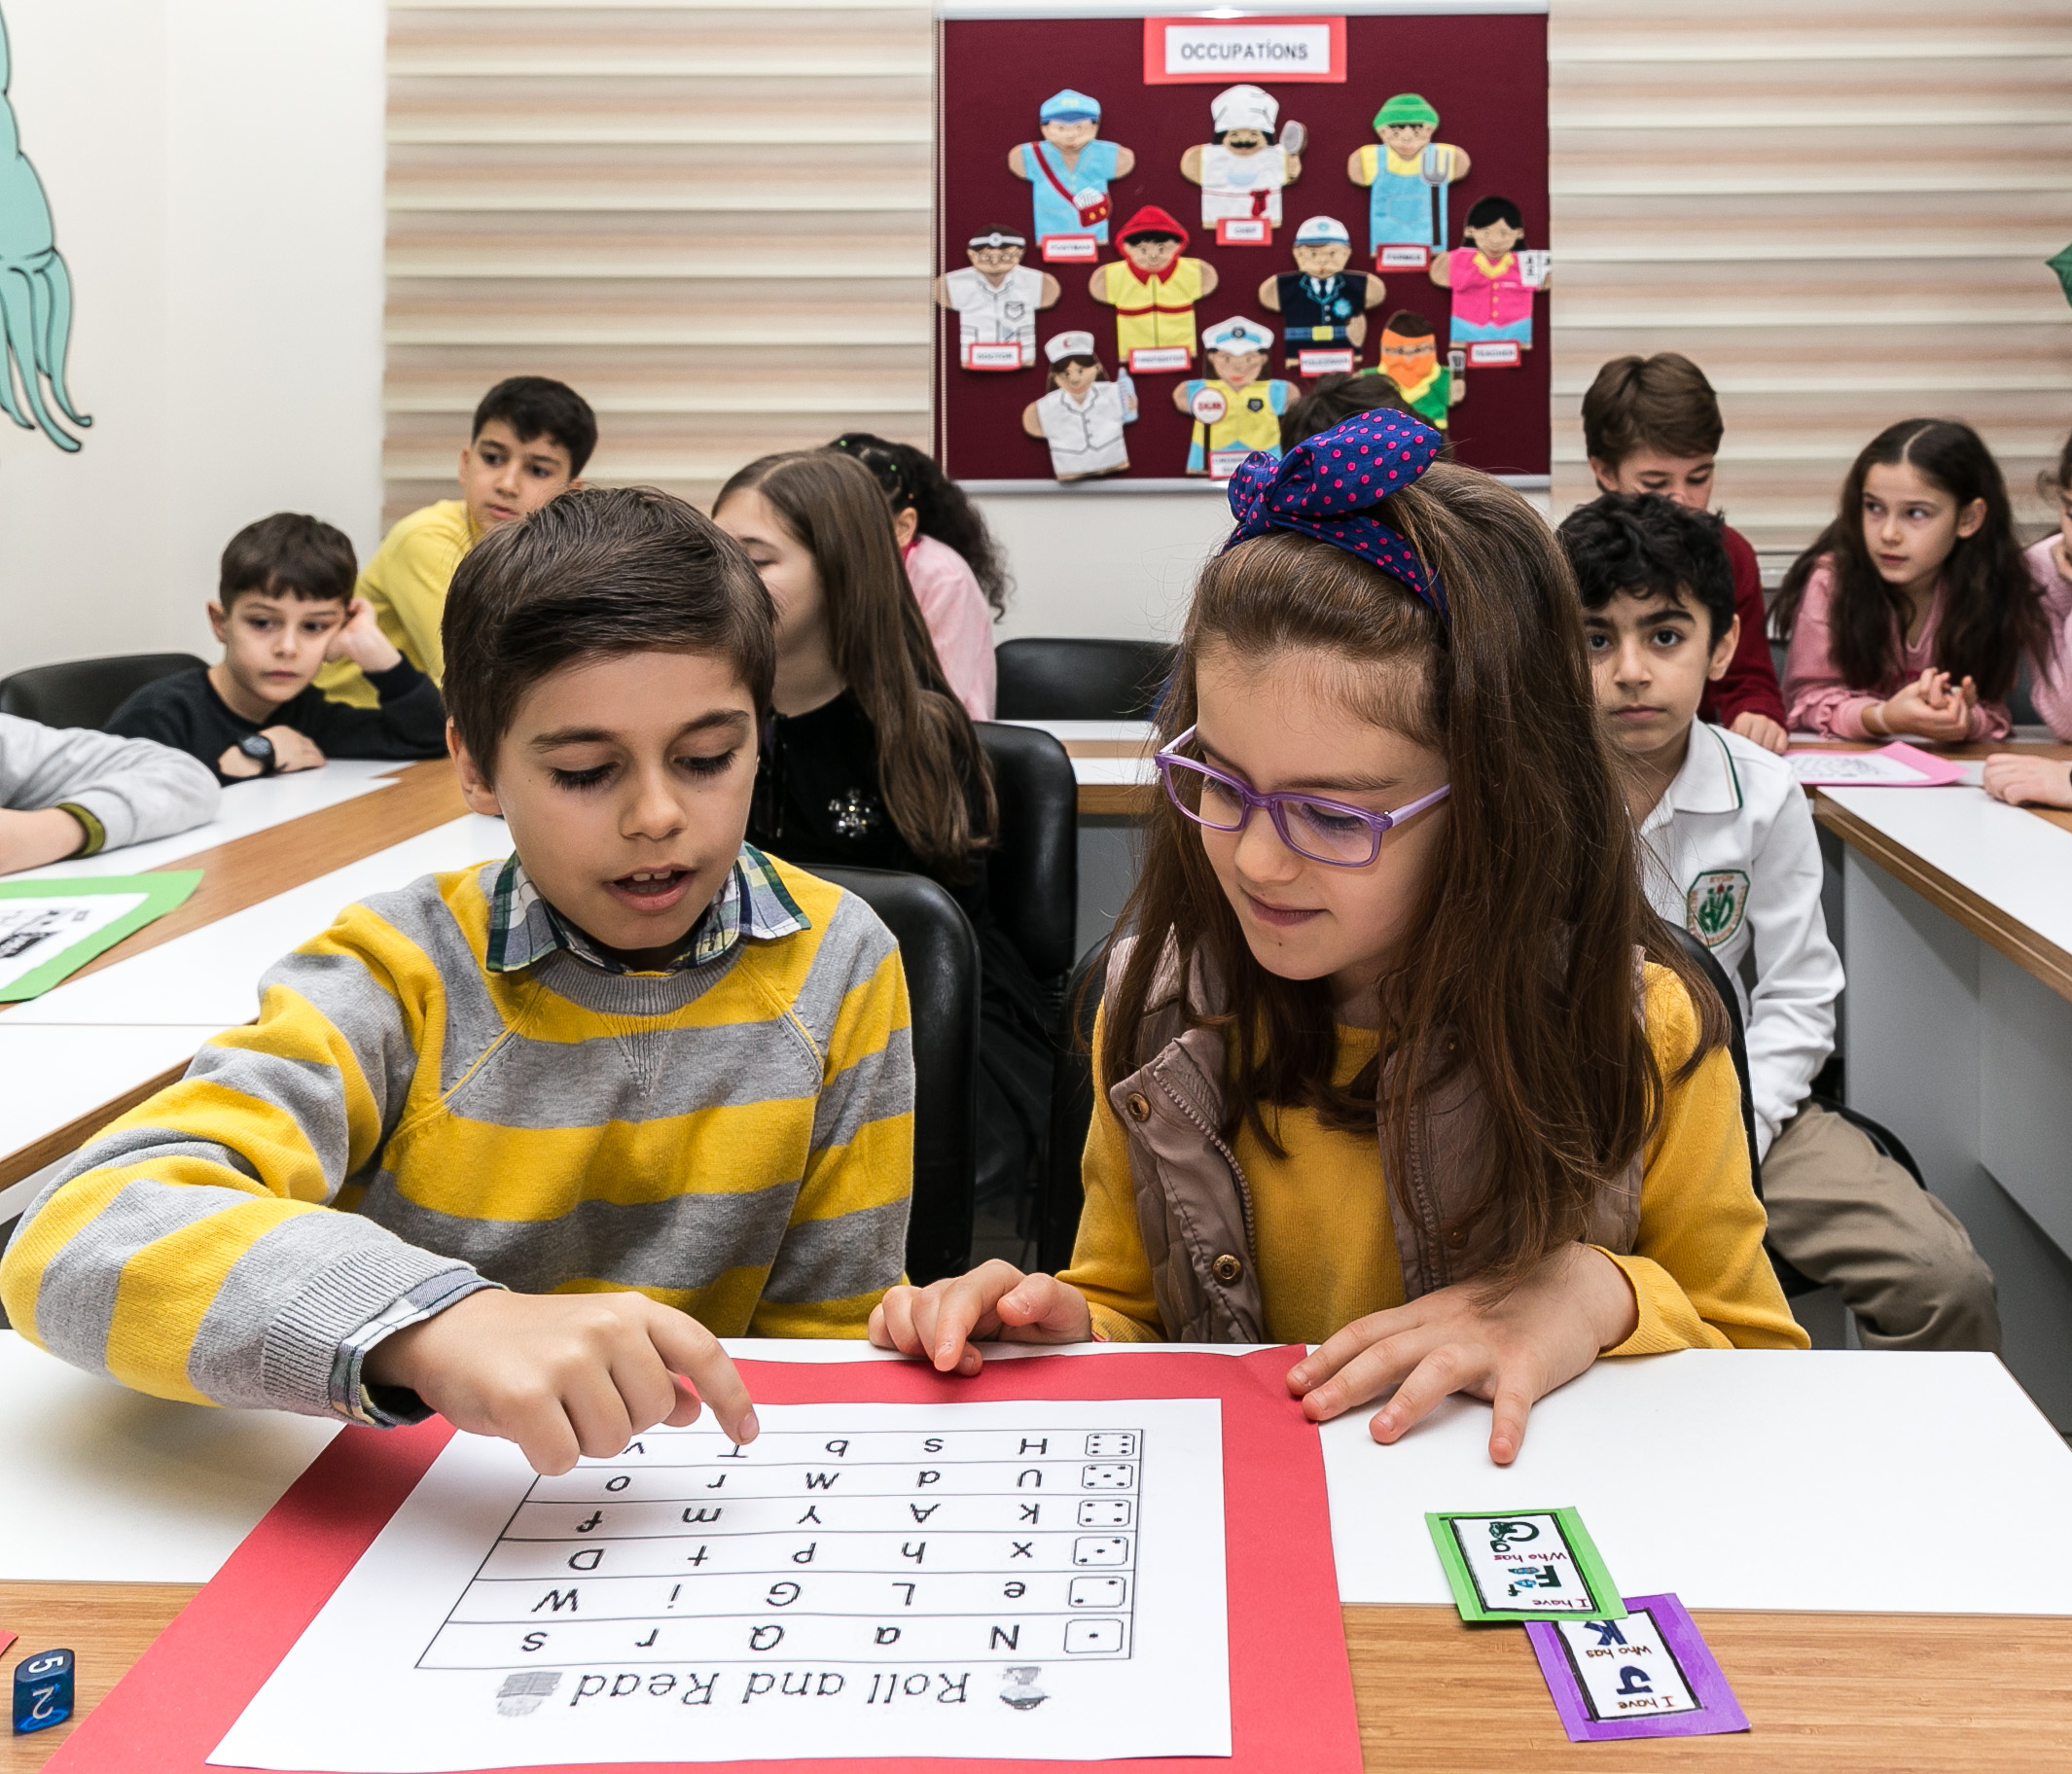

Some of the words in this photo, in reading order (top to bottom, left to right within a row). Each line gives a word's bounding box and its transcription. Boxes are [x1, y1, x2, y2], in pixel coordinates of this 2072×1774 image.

[824, 1438, 850, 1458] b
[1018, 1437, 1049, 1456] H
[705, 1473, 727, 1489] r
[804, 1472, 840, 1490] M
[915, 1470, 942, 1488] d
[1016, 1469, 1043, 1488] U
[575, 1509, 603, 1534] f
[681, 1507, 724, 1524] m
[796, 1505, 822, 1525] Y
[910, 1503, 942, 1524] A
[567, 1548, 605, 1572] D
[686, 1544, 709, 1567] t
[900, 1541, 927, 1565] h
[1528, 1552, 1567, 1561] Who
[1534, 1565, 1561, 1587] F
[530, 1588, 579, 1613] W
[669, 1583, 682, 1607] i
[766, 1580, 802, 1608] G
[891, 1581, 916, 1607] L
[1003, 1580, 1026, 1599] e
[633, 1627, 660, 1649] r
[748, 1624, 786, 1651] Q
[873, 1626, 902, 1646] a
[988, 1623, 1020, 1651] N
[1583, 1620, 1627, 1645] K
[1586, 1649, 1614, 1659] has
[1618, 1646, 1652, 1656] Who
[28, 1656, 63, 1673] 5
[569, 1672, 721, 1708] Read
[741, 1671, 845, 1705] and
[866, 1672, 972, 1705] Roll
[1616, 1665, 1653, 1693] J
[32, 1686, 54, 1719] 2
[1617, 1697, 1659, 1709] have
[1661, 1695, 1676, 1708] I
